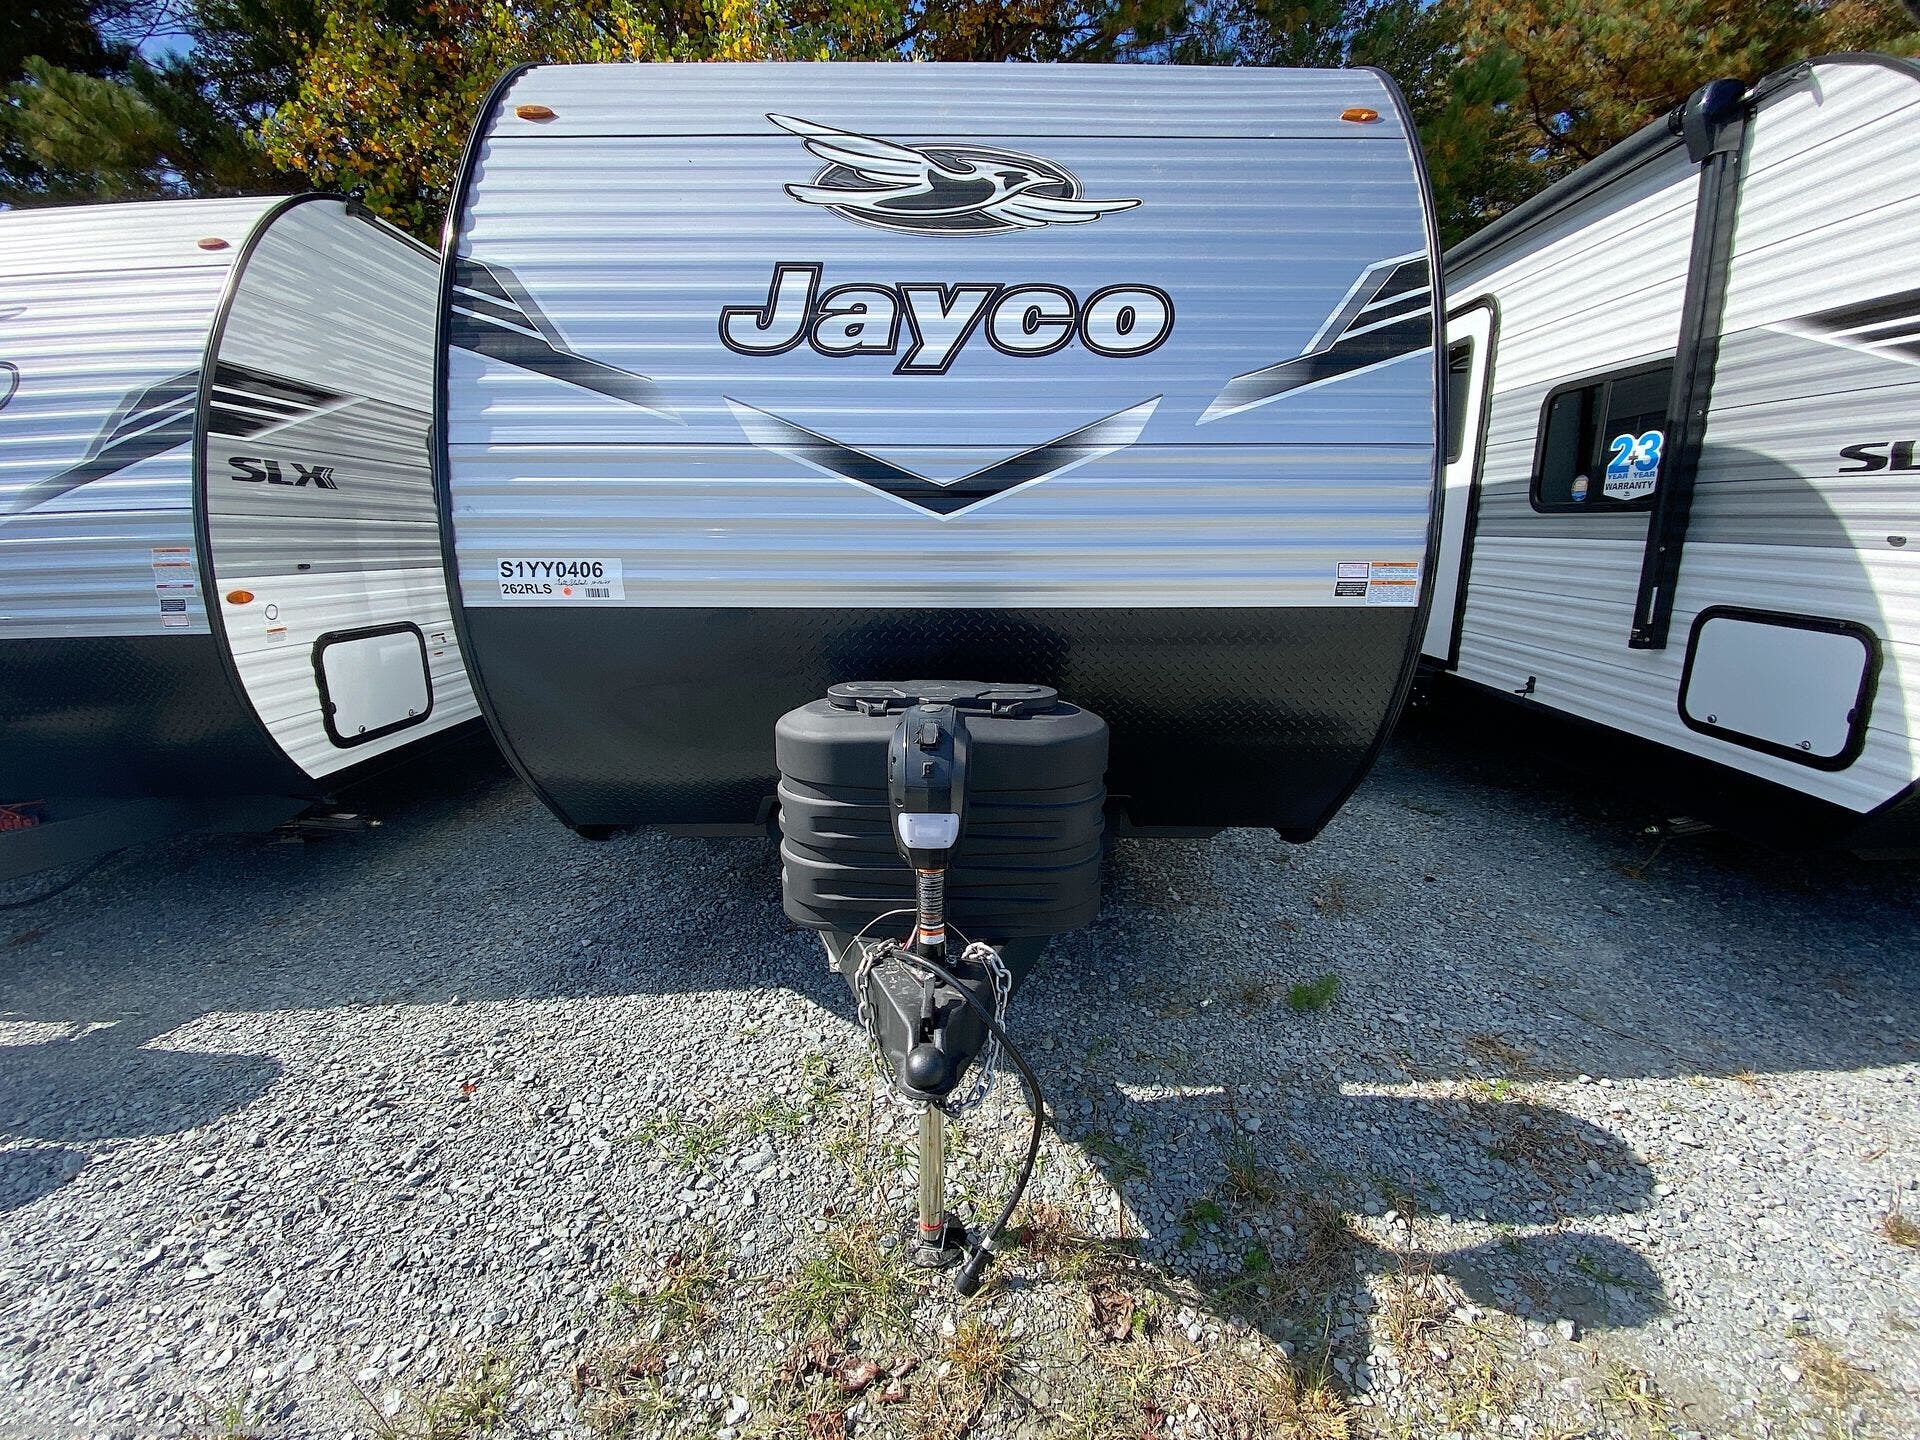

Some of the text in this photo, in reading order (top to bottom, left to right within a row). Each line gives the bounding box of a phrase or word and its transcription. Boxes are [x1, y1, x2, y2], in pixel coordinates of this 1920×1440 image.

[719, 262, 1175, 375] Jayco
[229, 457, 338, 490] SLX
[1606, 481, 1653, 491] WARRANTY
[501, 561, 603, 578] S1YY0406
[502, 583, 553, 595] 262RLS
